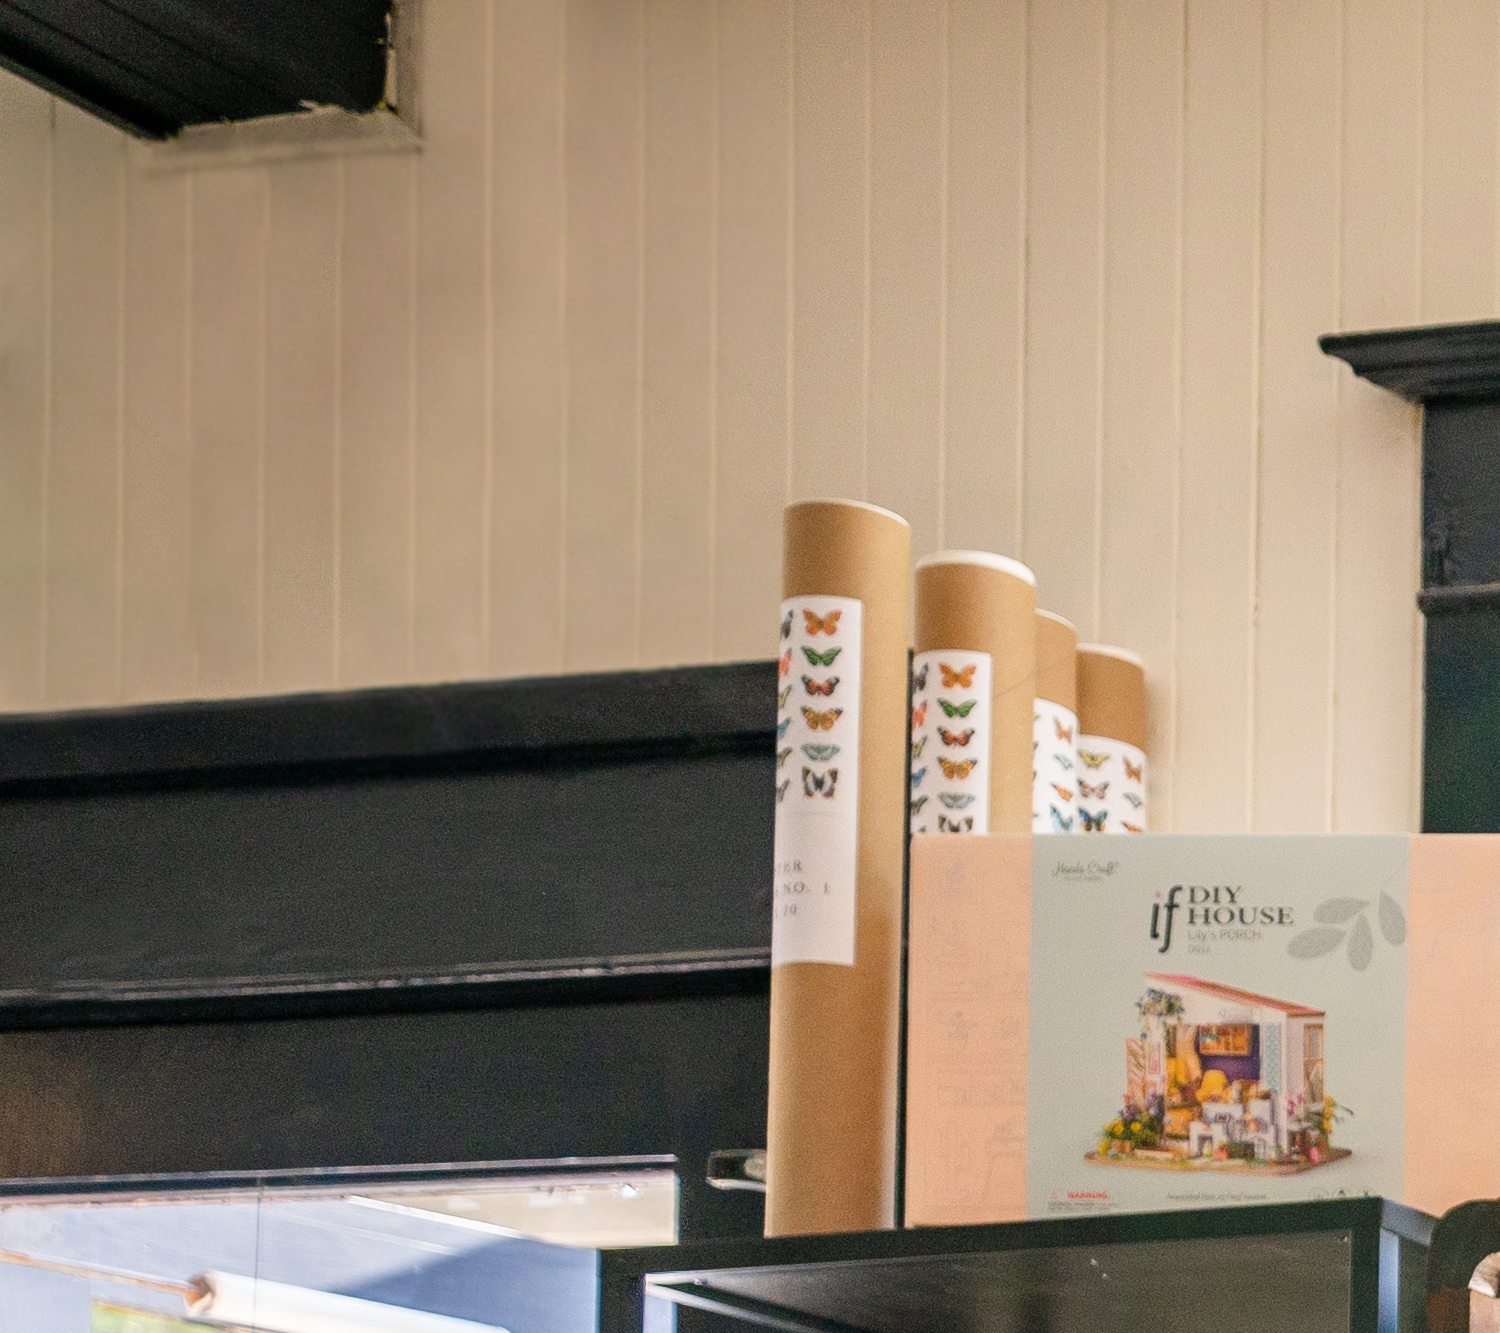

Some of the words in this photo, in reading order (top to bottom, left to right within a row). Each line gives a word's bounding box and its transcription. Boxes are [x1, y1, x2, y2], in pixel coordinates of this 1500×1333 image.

[1150, 885, 1183, 953] if
[1187, 884, 1244, 904] DIY
[1187, 905, 1295, 926] HOUSE
